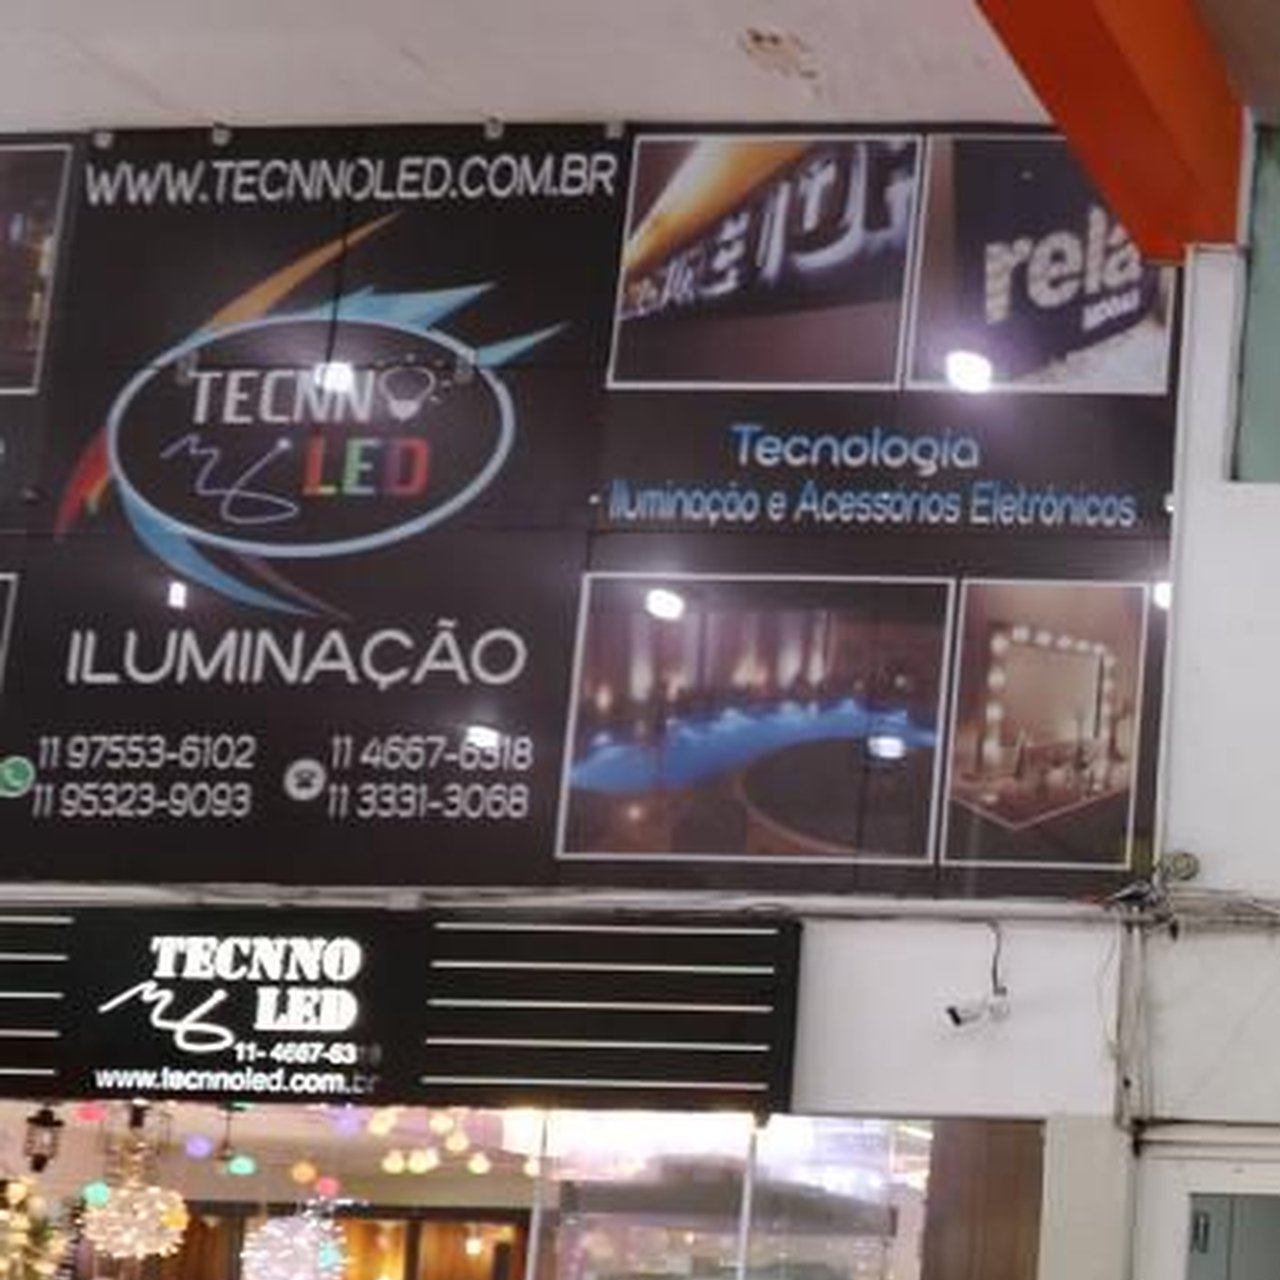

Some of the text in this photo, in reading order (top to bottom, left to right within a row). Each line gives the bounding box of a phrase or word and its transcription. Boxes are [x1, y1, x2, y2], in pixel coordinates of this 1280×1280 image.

[85, 154, 618, 205] WWW.TECNNOLED.COM.BR
[302, 433, 429, 495] LED
[731, 425, 980, 476] Tecnologia
[608, 479, 758, 528] Iluminação
[767, 493, 785, 523] e
[799, 480, 960, 524] Acessórios
[65, 618, 528, 691] ILUMINAÇÃO
[66, 734, 256, 769] 97553-6102
[60, 782, 252, 817] 95323-9093
[357, 782, 529, 818] 3331-3068
[150, 936, 362, 980] TECNNO
[254, 986, 358, 1031] LED
